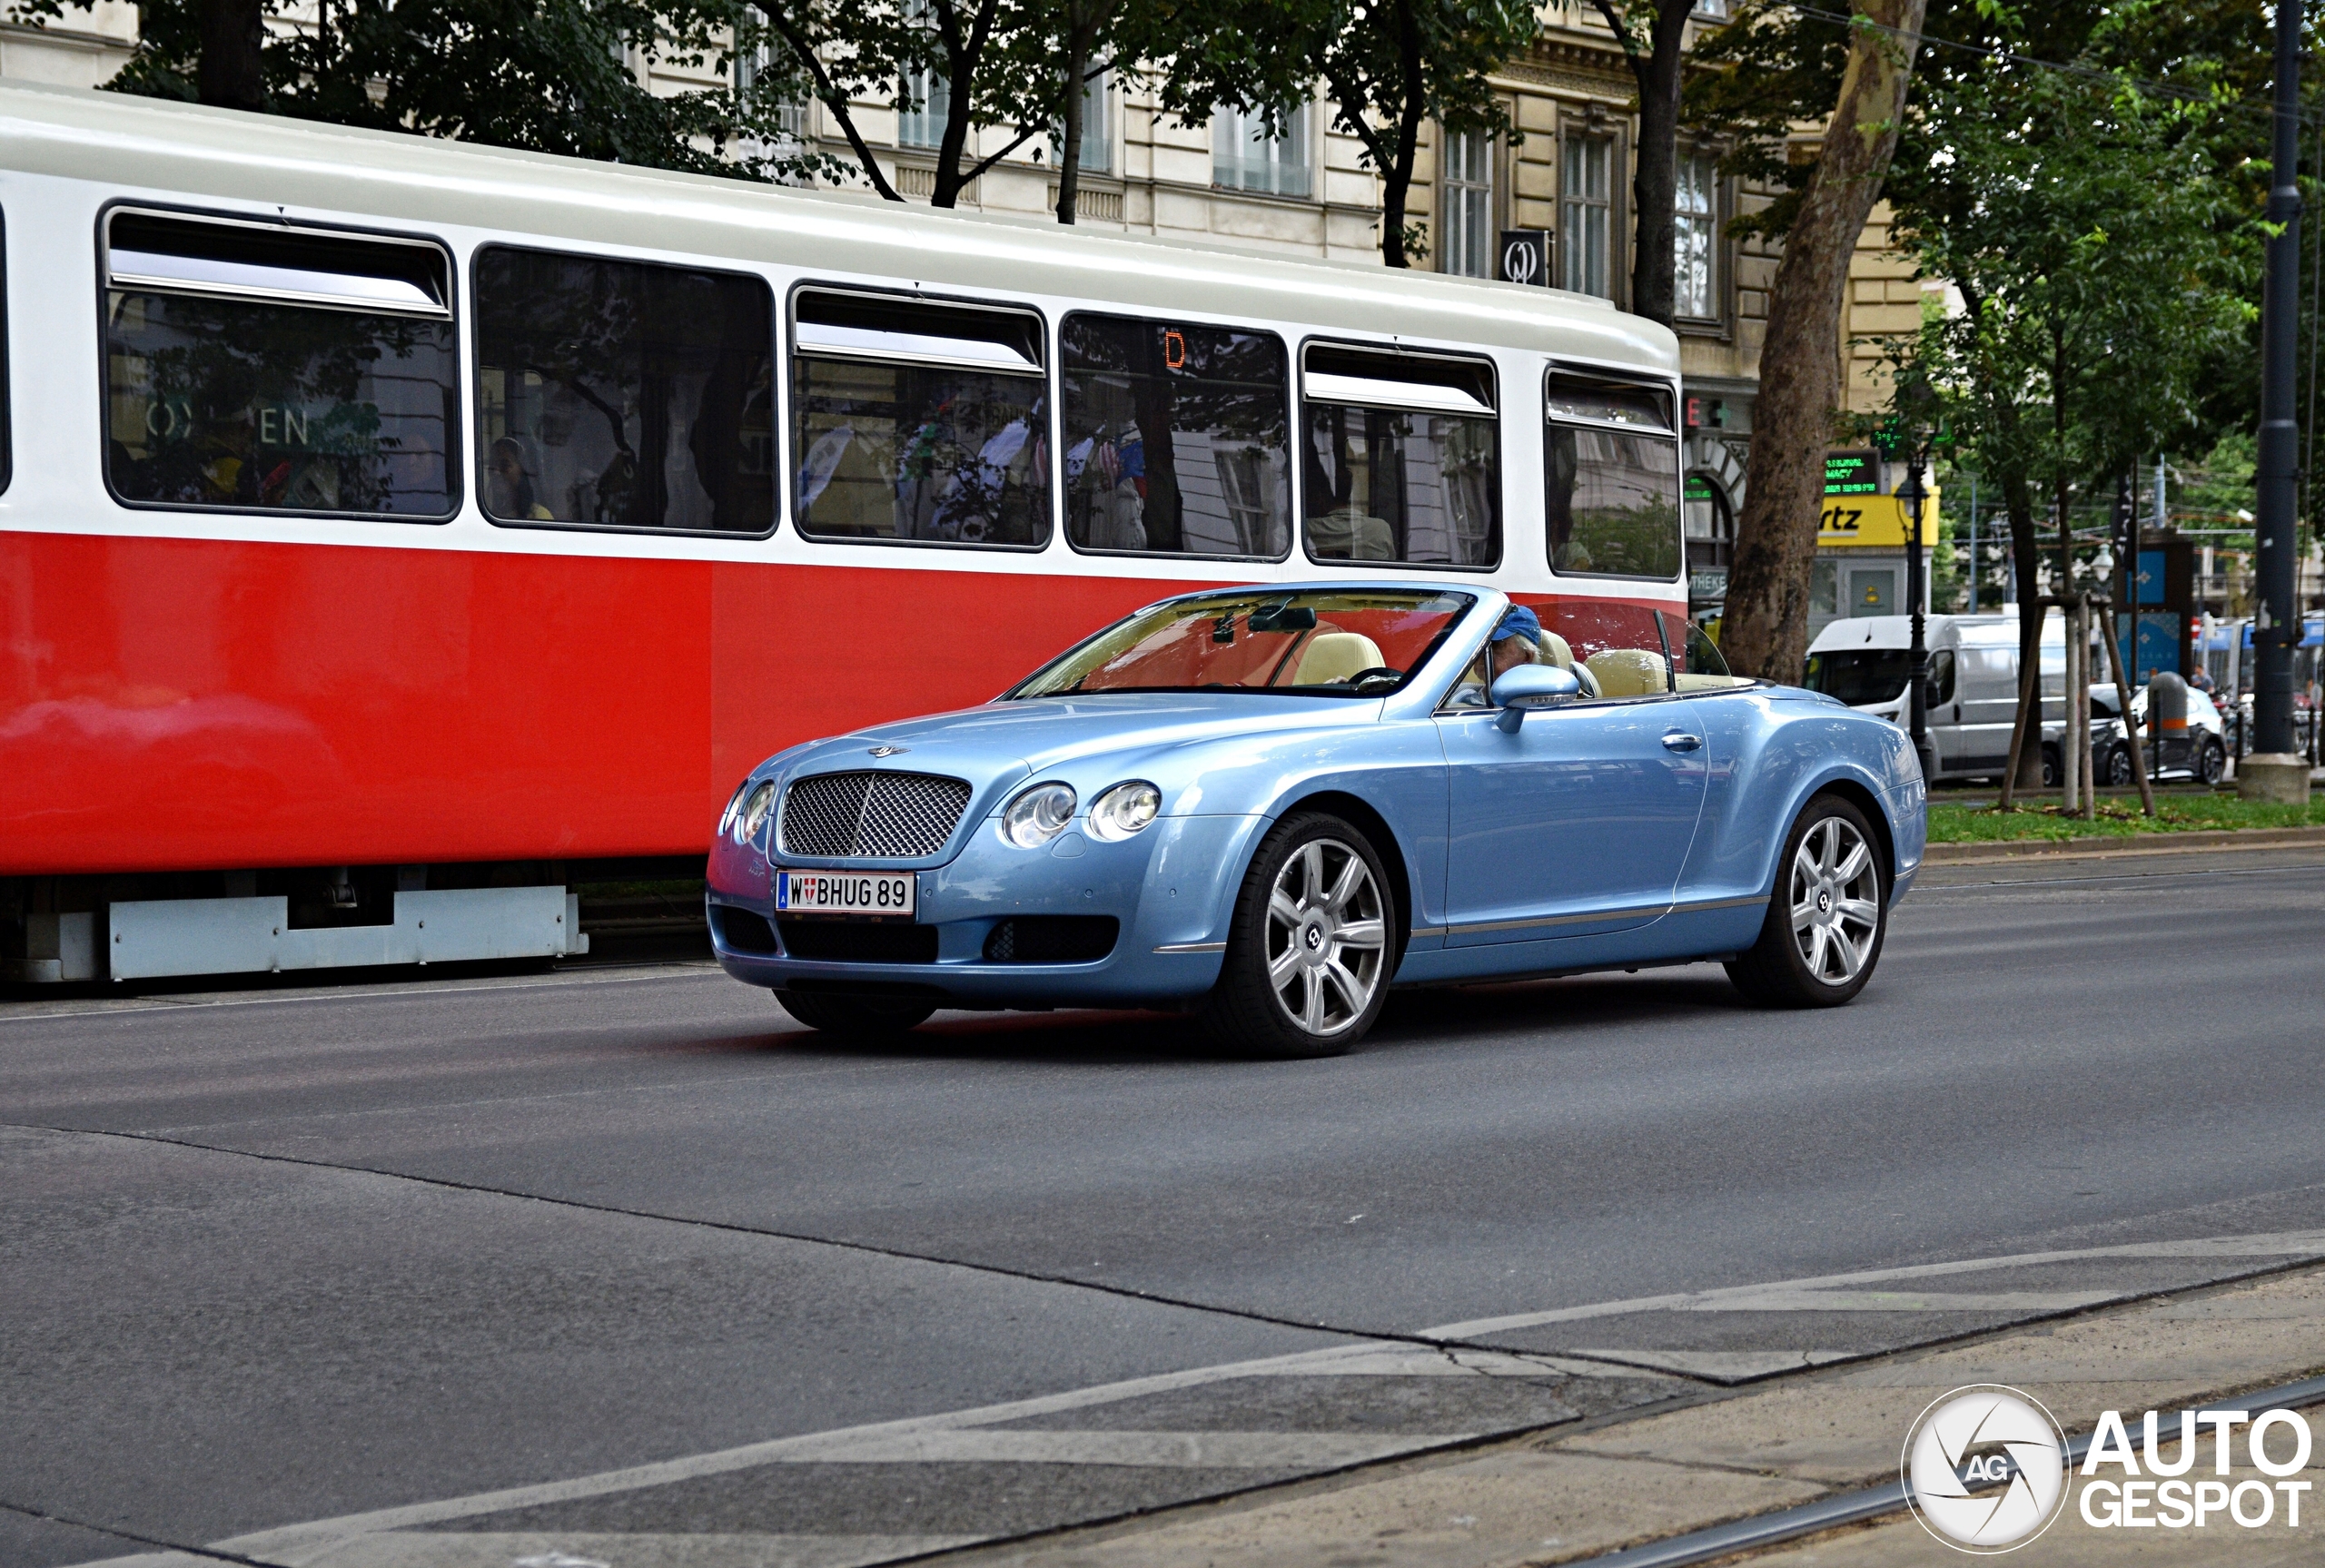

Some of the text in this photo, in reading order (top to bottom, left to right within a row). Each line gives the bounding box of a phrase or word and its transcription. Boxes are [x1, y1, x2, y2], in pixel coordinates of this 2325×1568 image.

[1165, 331, 1185, 369] D
[1687, 398, 1701, 427] E
[1819, 505, 1863, 530] rtz
[1689, 575, 1726, 590] THEKE
[780, 895, 786, 904] A
[790, 877, 906, 907] W BHUG 89
